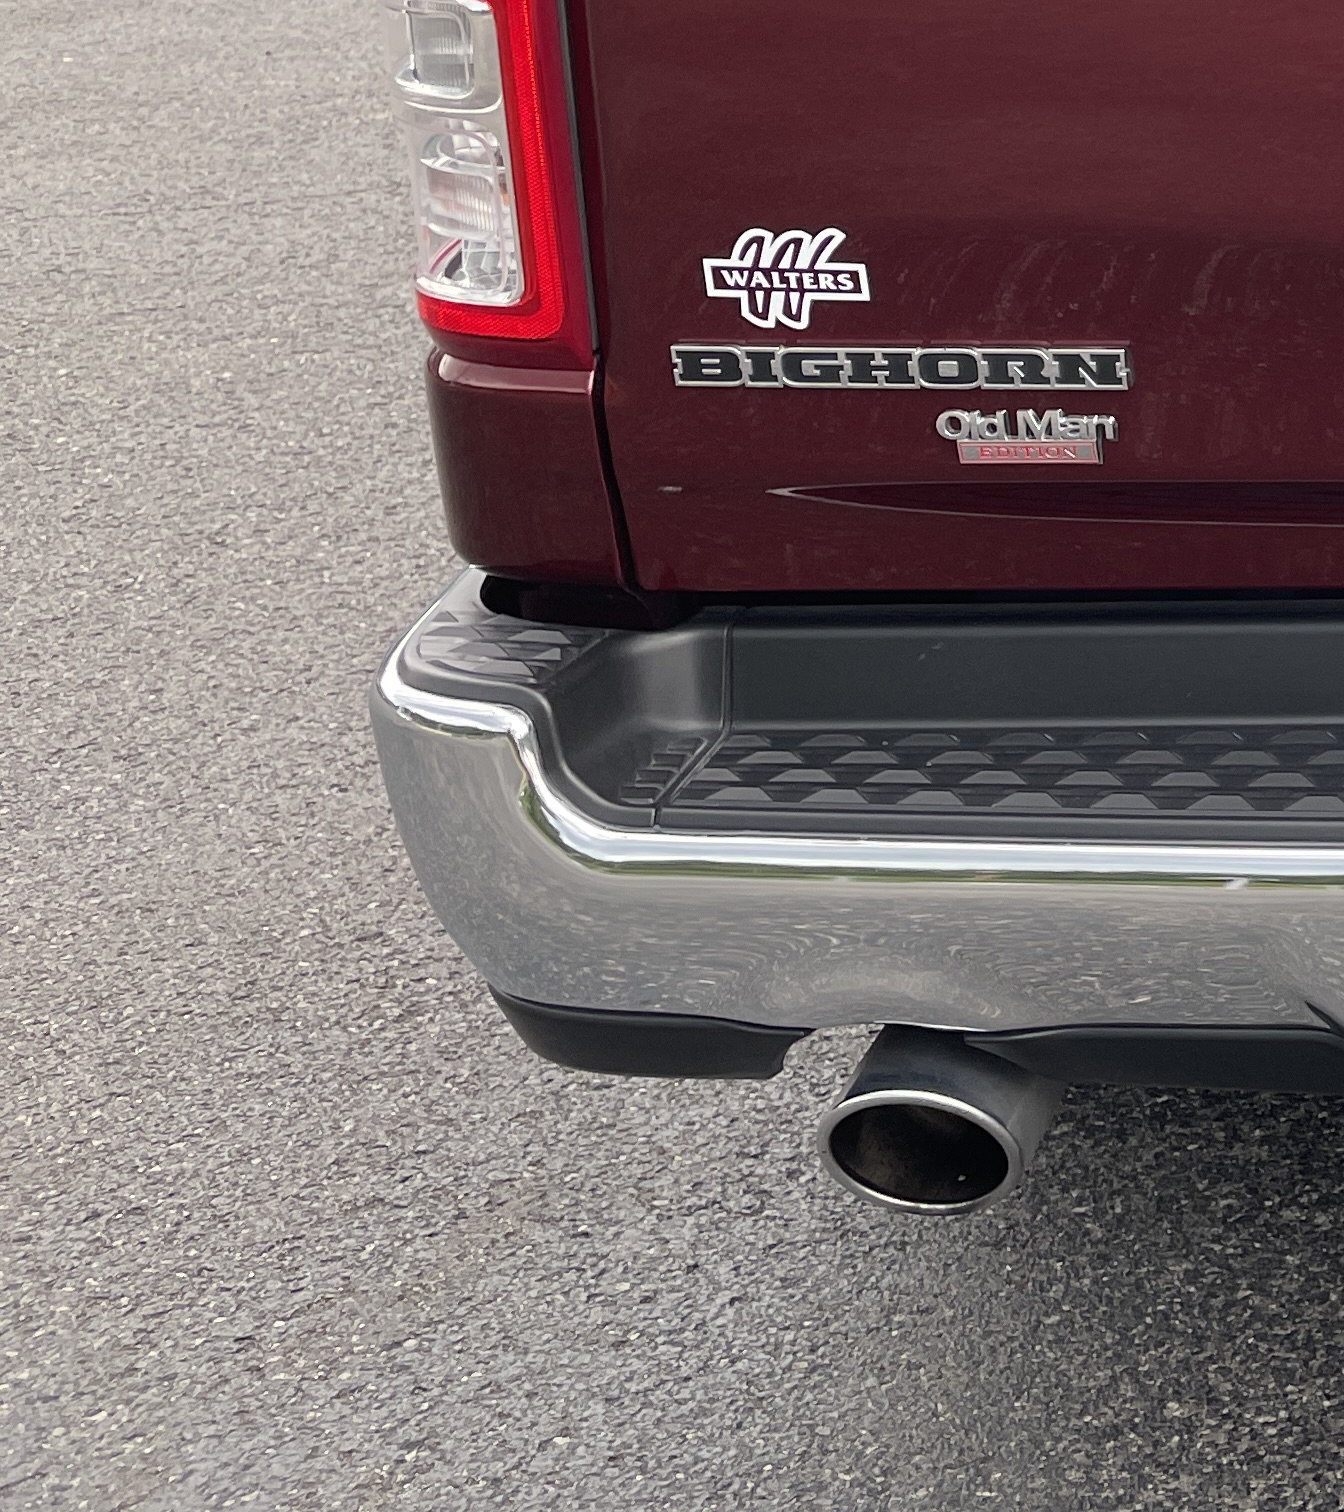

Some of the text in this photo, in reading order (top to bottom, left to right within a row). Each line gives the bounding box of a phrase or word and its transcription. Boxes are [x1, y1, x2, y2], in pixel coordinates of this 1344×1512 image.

[720, 268, 855, 292] WALTERS
[670, 344, 1131, 391] BIGHORN
[935, 408, 1118, 442] Old Man
[978, 445, 1077, 460] EDITION
